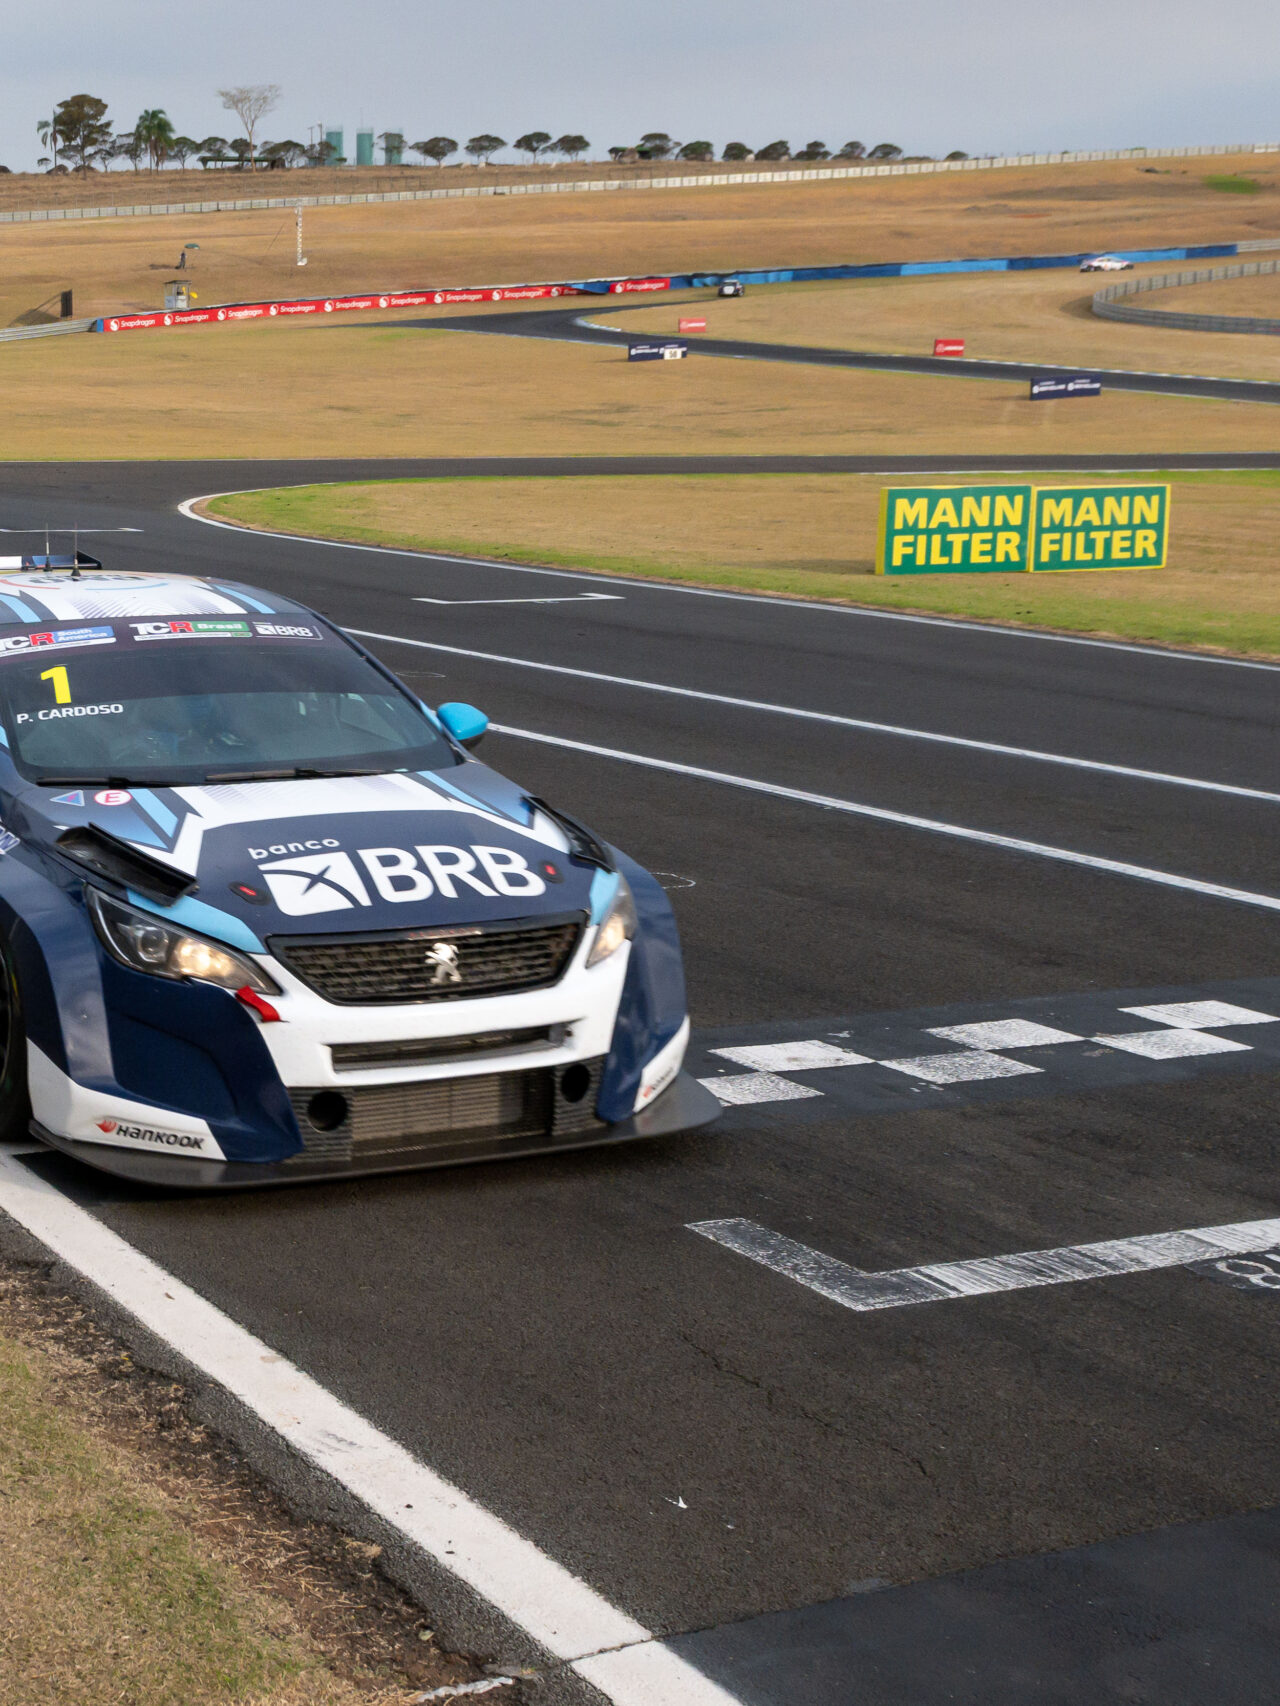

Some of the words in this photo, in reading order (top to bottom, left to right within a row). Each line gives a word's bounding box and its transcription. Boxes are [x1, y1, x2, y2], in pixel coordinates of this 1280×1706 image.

[626, 281, 665, 291] Snapdragon
[446, 293, 483, 301] Snapdragon
[504, 290, 543, 299] Snapdragon
[335, 301, 371, 309] Snapdragon
[391, 296, 426, 305] Snapdragon
[228, 309, 263, 318] Snapdragon
[280, 305, 315, 313] Snapdragon
[120, 319, 155, 327] Snapdragon
[174, 314, 209, 323] Snapdragon
[894, 495, 1023, 529] MANN
[1042, 495, 1159, 528] MANN
[892, 531, 1021, 566] FILTER
[1040, 529, 1157, 562] FILTER
[57, 629, 93, 637] South
[129, 621, 195, 635] TCR
[275, 625, 314, 637] BRB
[57, 632, 108, 642] America
[41, 666, 72, 704] 1
[16, 713, 34, 724] P.
[38, 703, 124, 720] CARDOSO
[104, 791, 122, 803] E
[248, 837, 340, 859] banco
[355, 844, 547, 903] BRB
